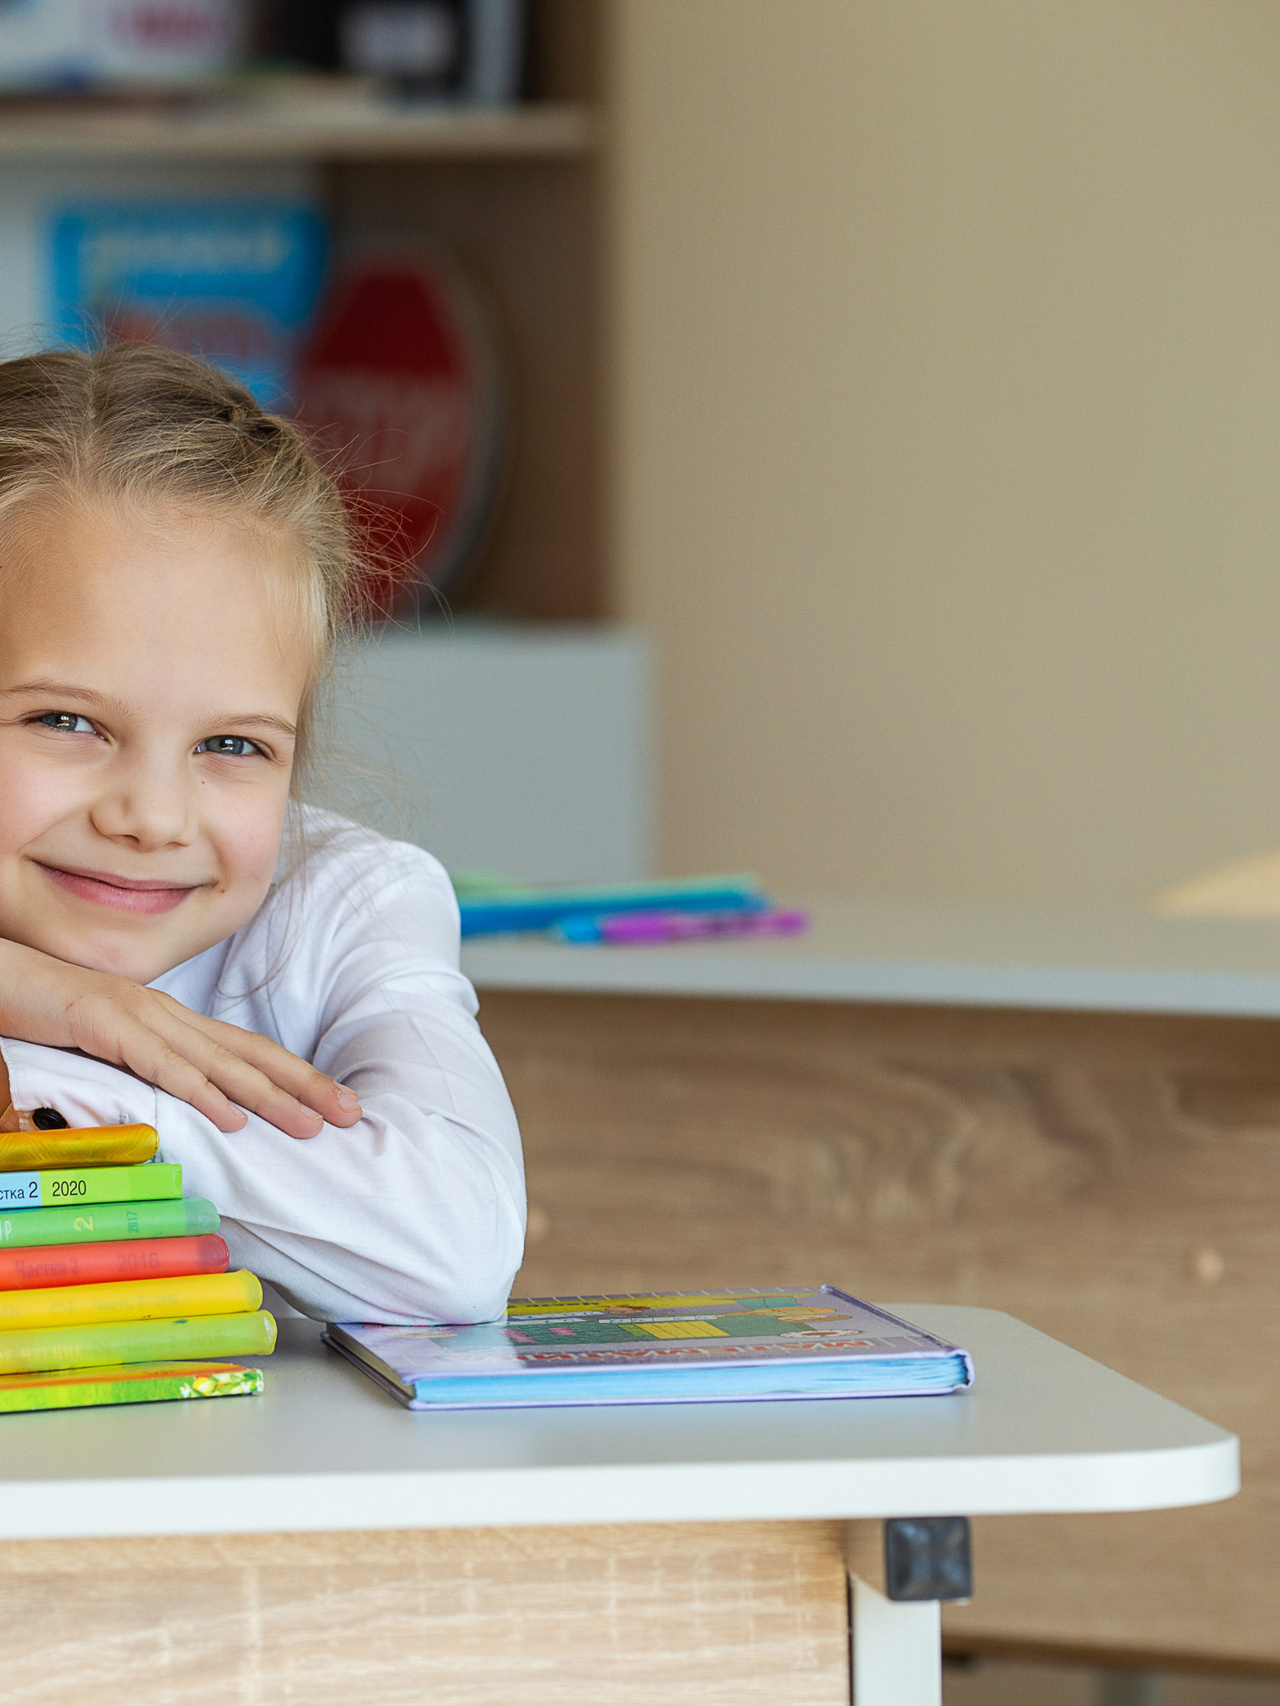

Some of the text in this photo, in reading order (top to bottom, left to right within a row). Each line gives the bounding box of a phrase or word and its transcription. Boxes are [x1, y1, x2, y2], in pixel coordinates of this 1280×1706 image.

[28, 1181, 39, 1199] 2
[51, 1180, 87, 1198] 2020
[74, 1214, 95, 1233] 2
[127, 1210, 138, 1235] 2017
